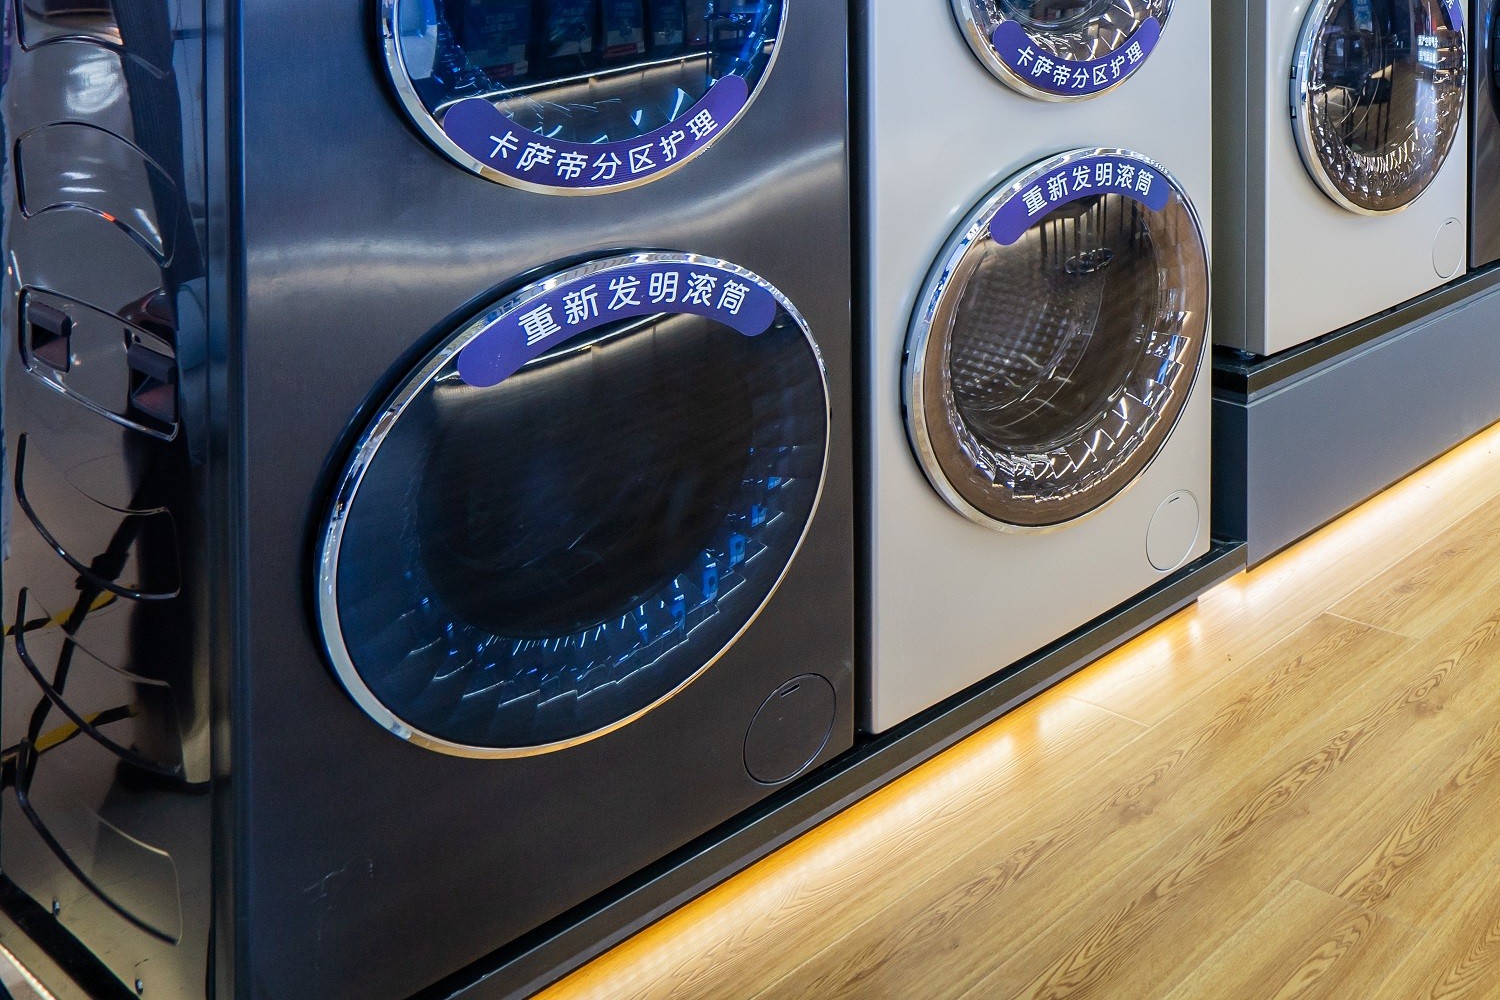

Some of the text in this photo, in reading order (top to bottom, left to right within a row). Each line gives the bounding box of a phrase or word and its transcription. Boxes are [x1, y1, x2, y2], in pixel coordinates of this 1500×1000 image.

[1017, 41, 1144, 89] 卡萨帝分区护理
[489, 108, 719, 181] 卡萨帝分区护理
[1022, 162, 1155, 217] 重新发明滚筒
[518, 271, 751, 346] 重新发明滚筒
